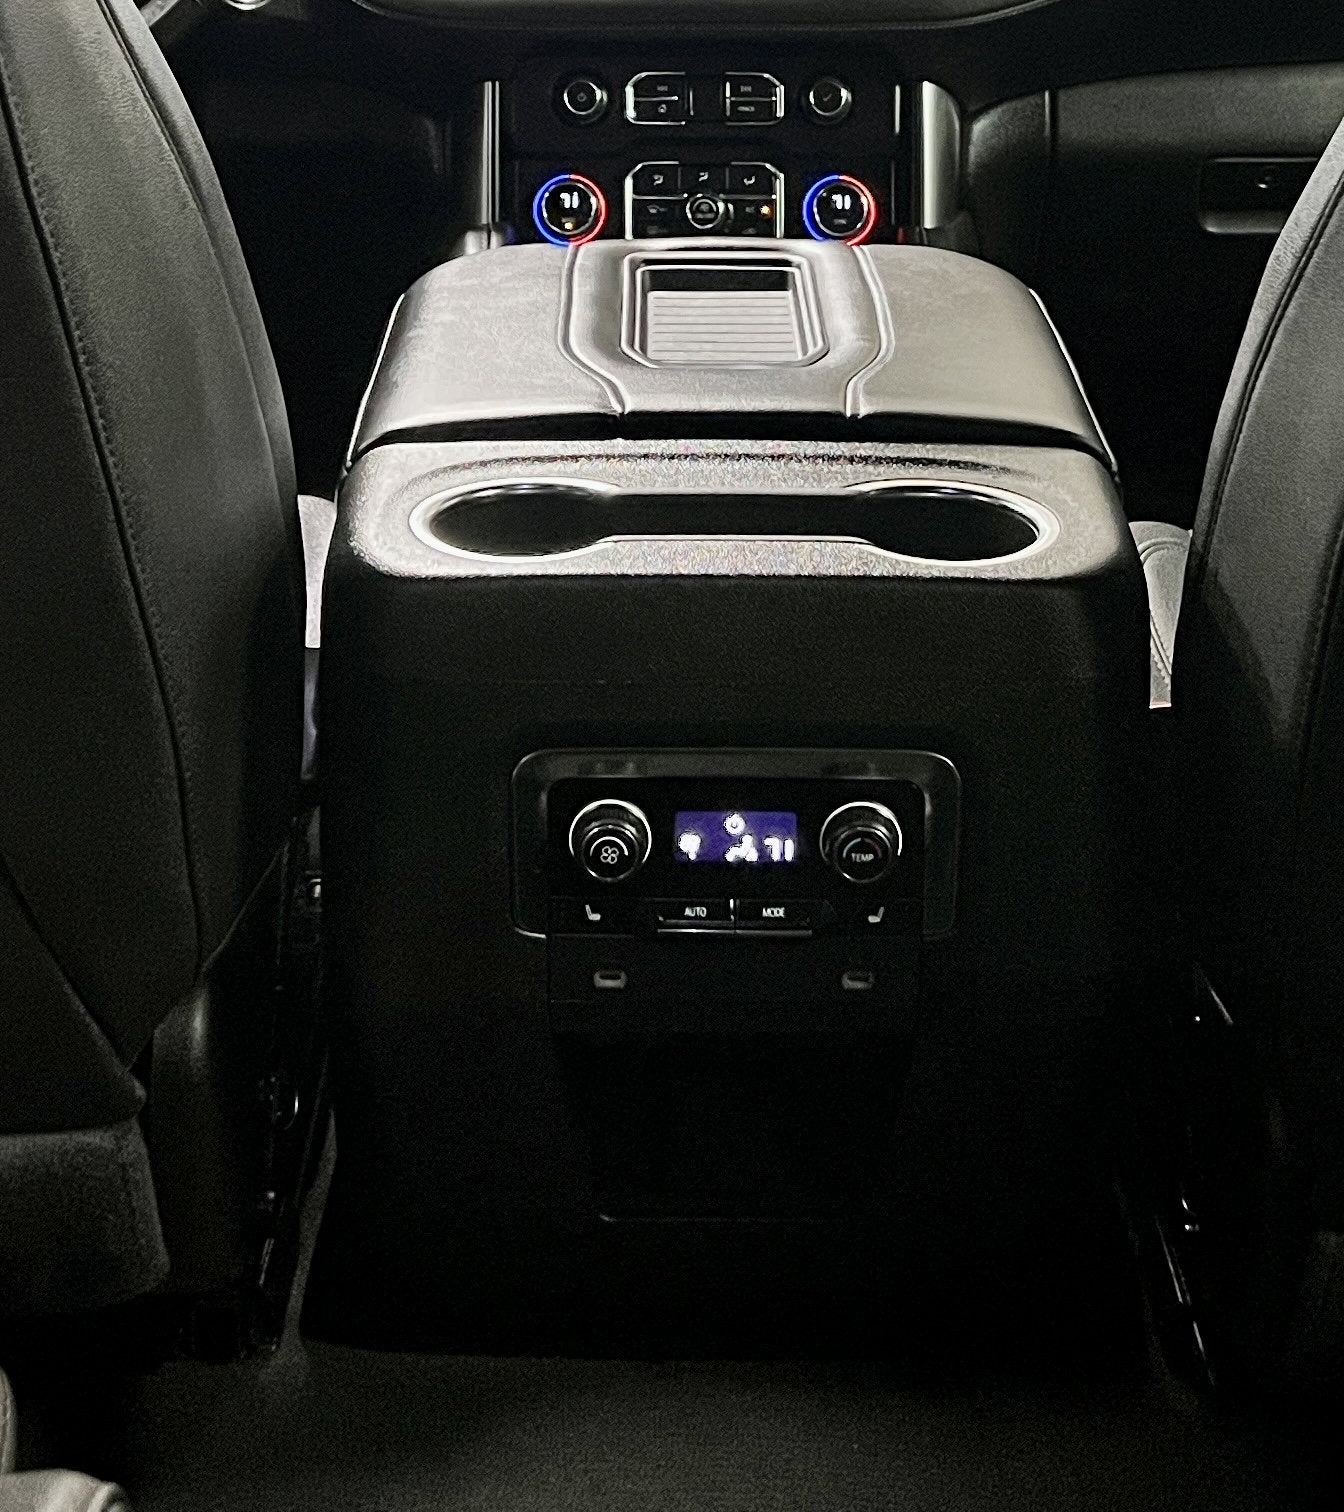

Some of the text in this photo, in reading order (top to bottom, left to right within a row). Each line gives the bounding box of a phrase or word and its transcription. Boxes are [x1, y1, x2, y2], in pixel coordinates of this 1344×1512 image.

[763, 835, 795, 862] 71
[851, 853, 875, 862] TEMP
[684, 906, 707, 917] AUTO
[762, 907, 785, 918] MODE
